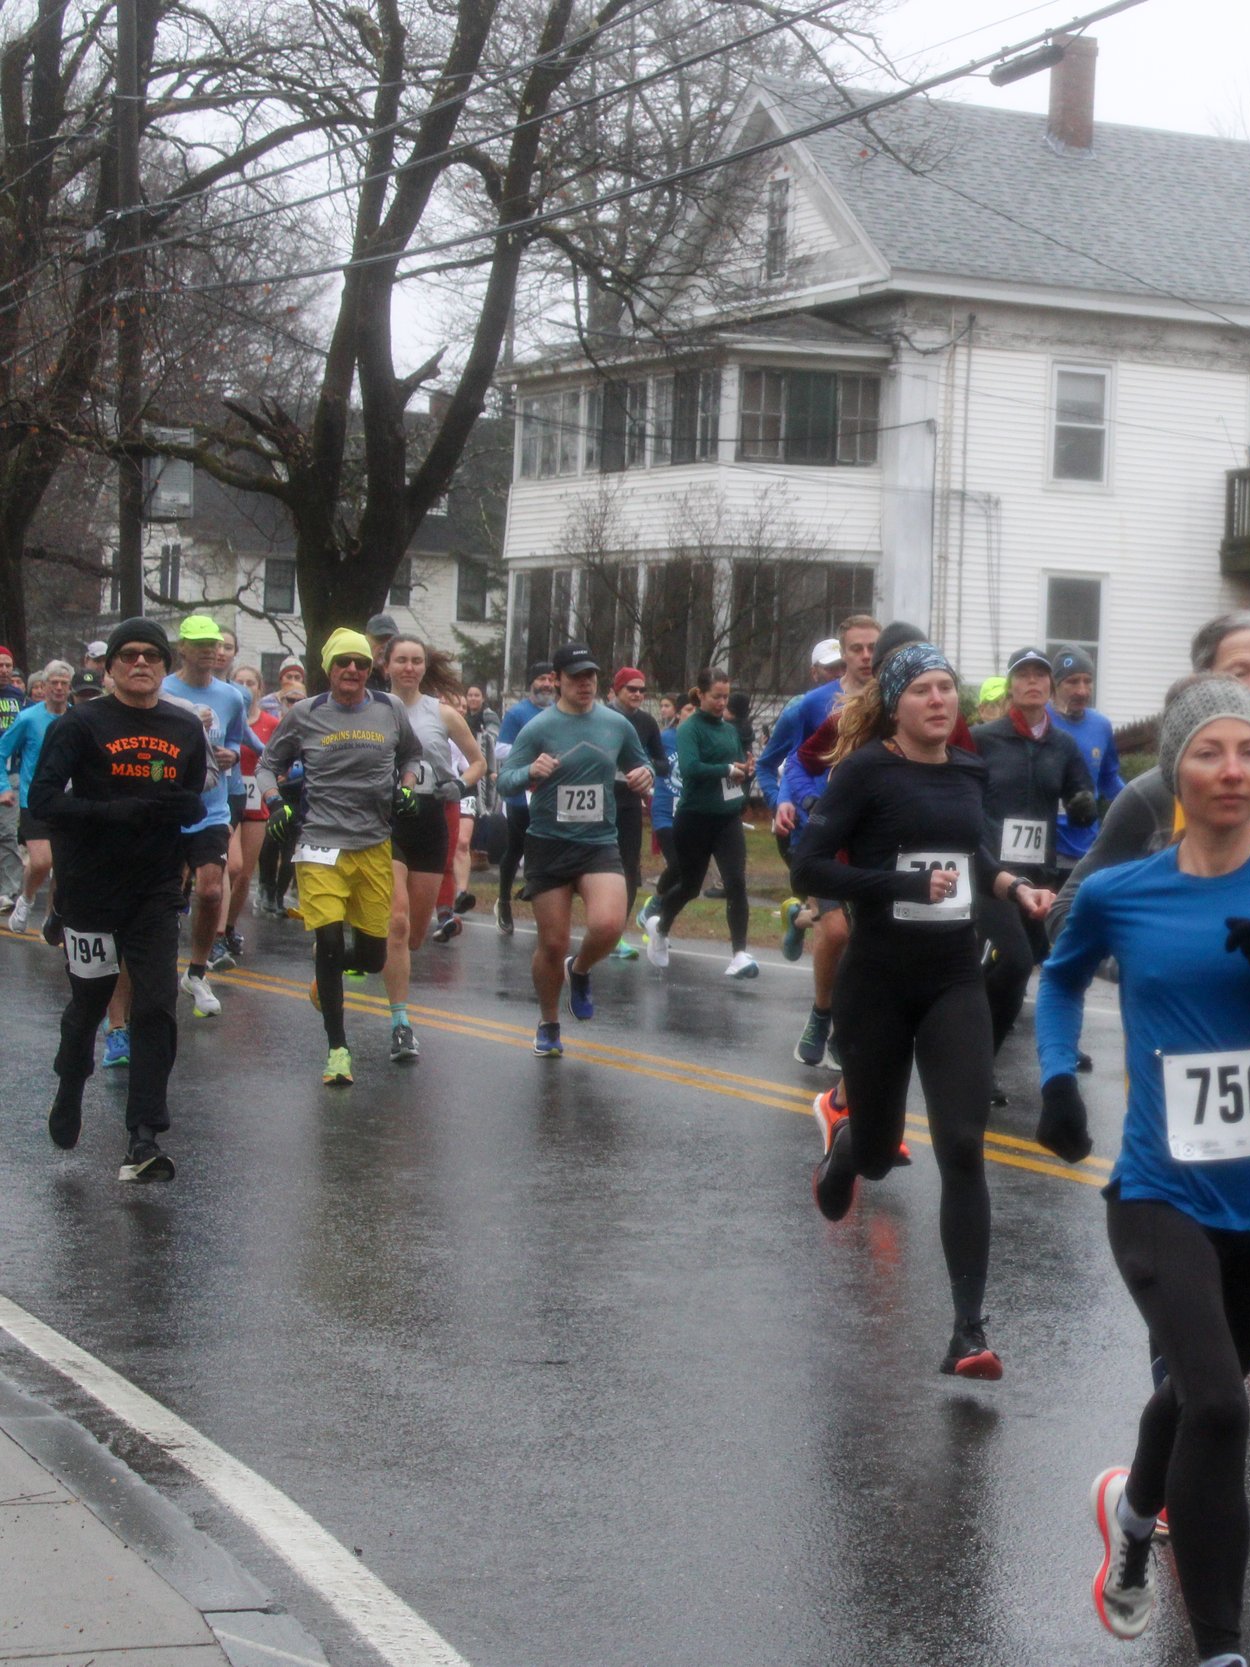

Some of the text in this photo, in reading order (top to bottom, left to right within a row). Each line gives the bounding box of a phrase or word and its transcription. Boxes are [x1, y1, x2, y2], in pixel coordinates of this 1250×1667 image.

[105, 736, 180, 759] WESTERN
[321, 729, 385, 747] HOPKINS ACADEMY
[111, 763, 177, 779] MASS 10
[565, 789, 597, 811] 723
[1012, 825, 1042, 850] 776
[70, 934, 107, 965] 794
